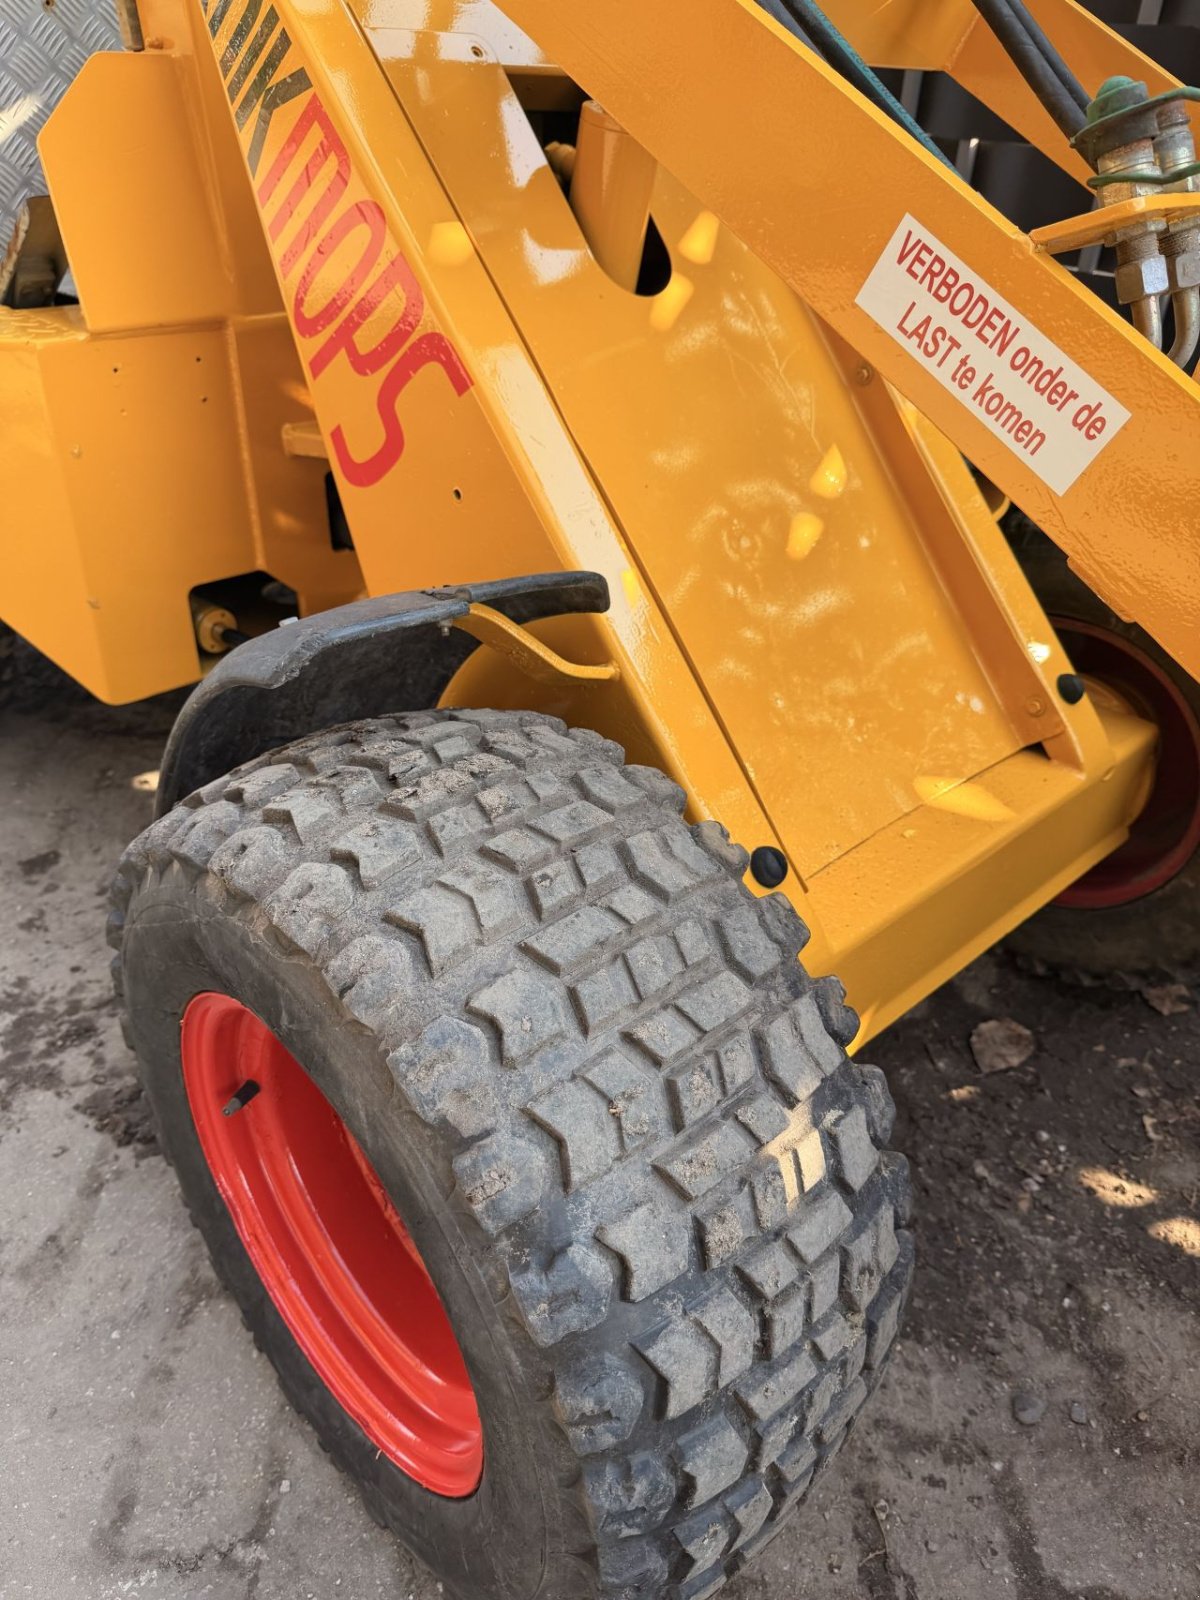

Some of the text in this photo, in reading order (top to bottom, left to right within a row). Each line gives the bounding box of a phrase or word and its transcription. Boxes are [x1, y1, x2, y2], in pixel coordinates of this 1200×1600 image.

[896, 230, 1107, 441] VERBODEN onder de
[896, 302, 1046, 456] LAST te komen
